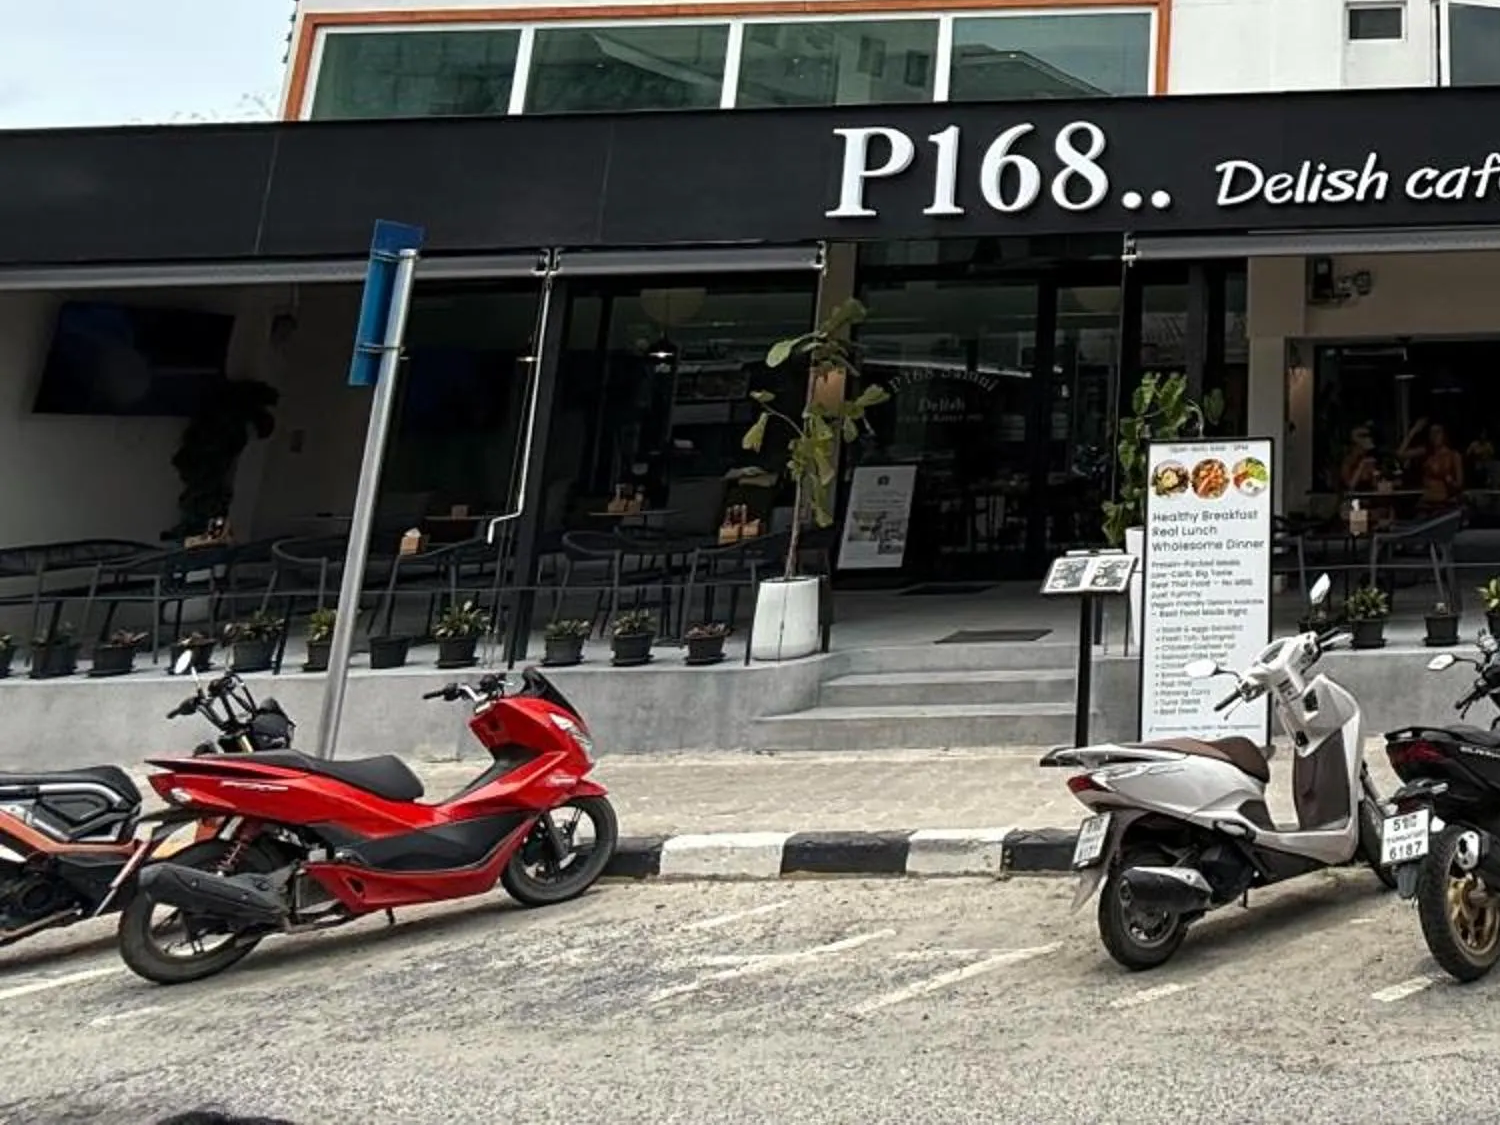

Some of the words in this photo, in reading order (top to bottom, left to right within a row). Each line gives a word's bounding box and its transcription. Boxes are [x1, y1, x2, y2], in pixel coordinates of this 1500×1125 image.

[1214, 152, 1389, 207] Delish
[1152, 510, 1199, 523] Healthy
[1201, 509, 1259, 522] Breakfast
[1152, 526, 1179, 537] Real
[1181, 525, 1218, 537] Lunch
[1151, 540, 1223, 552] Wholesome
[1226, 538, 1265, 550] Dinner
